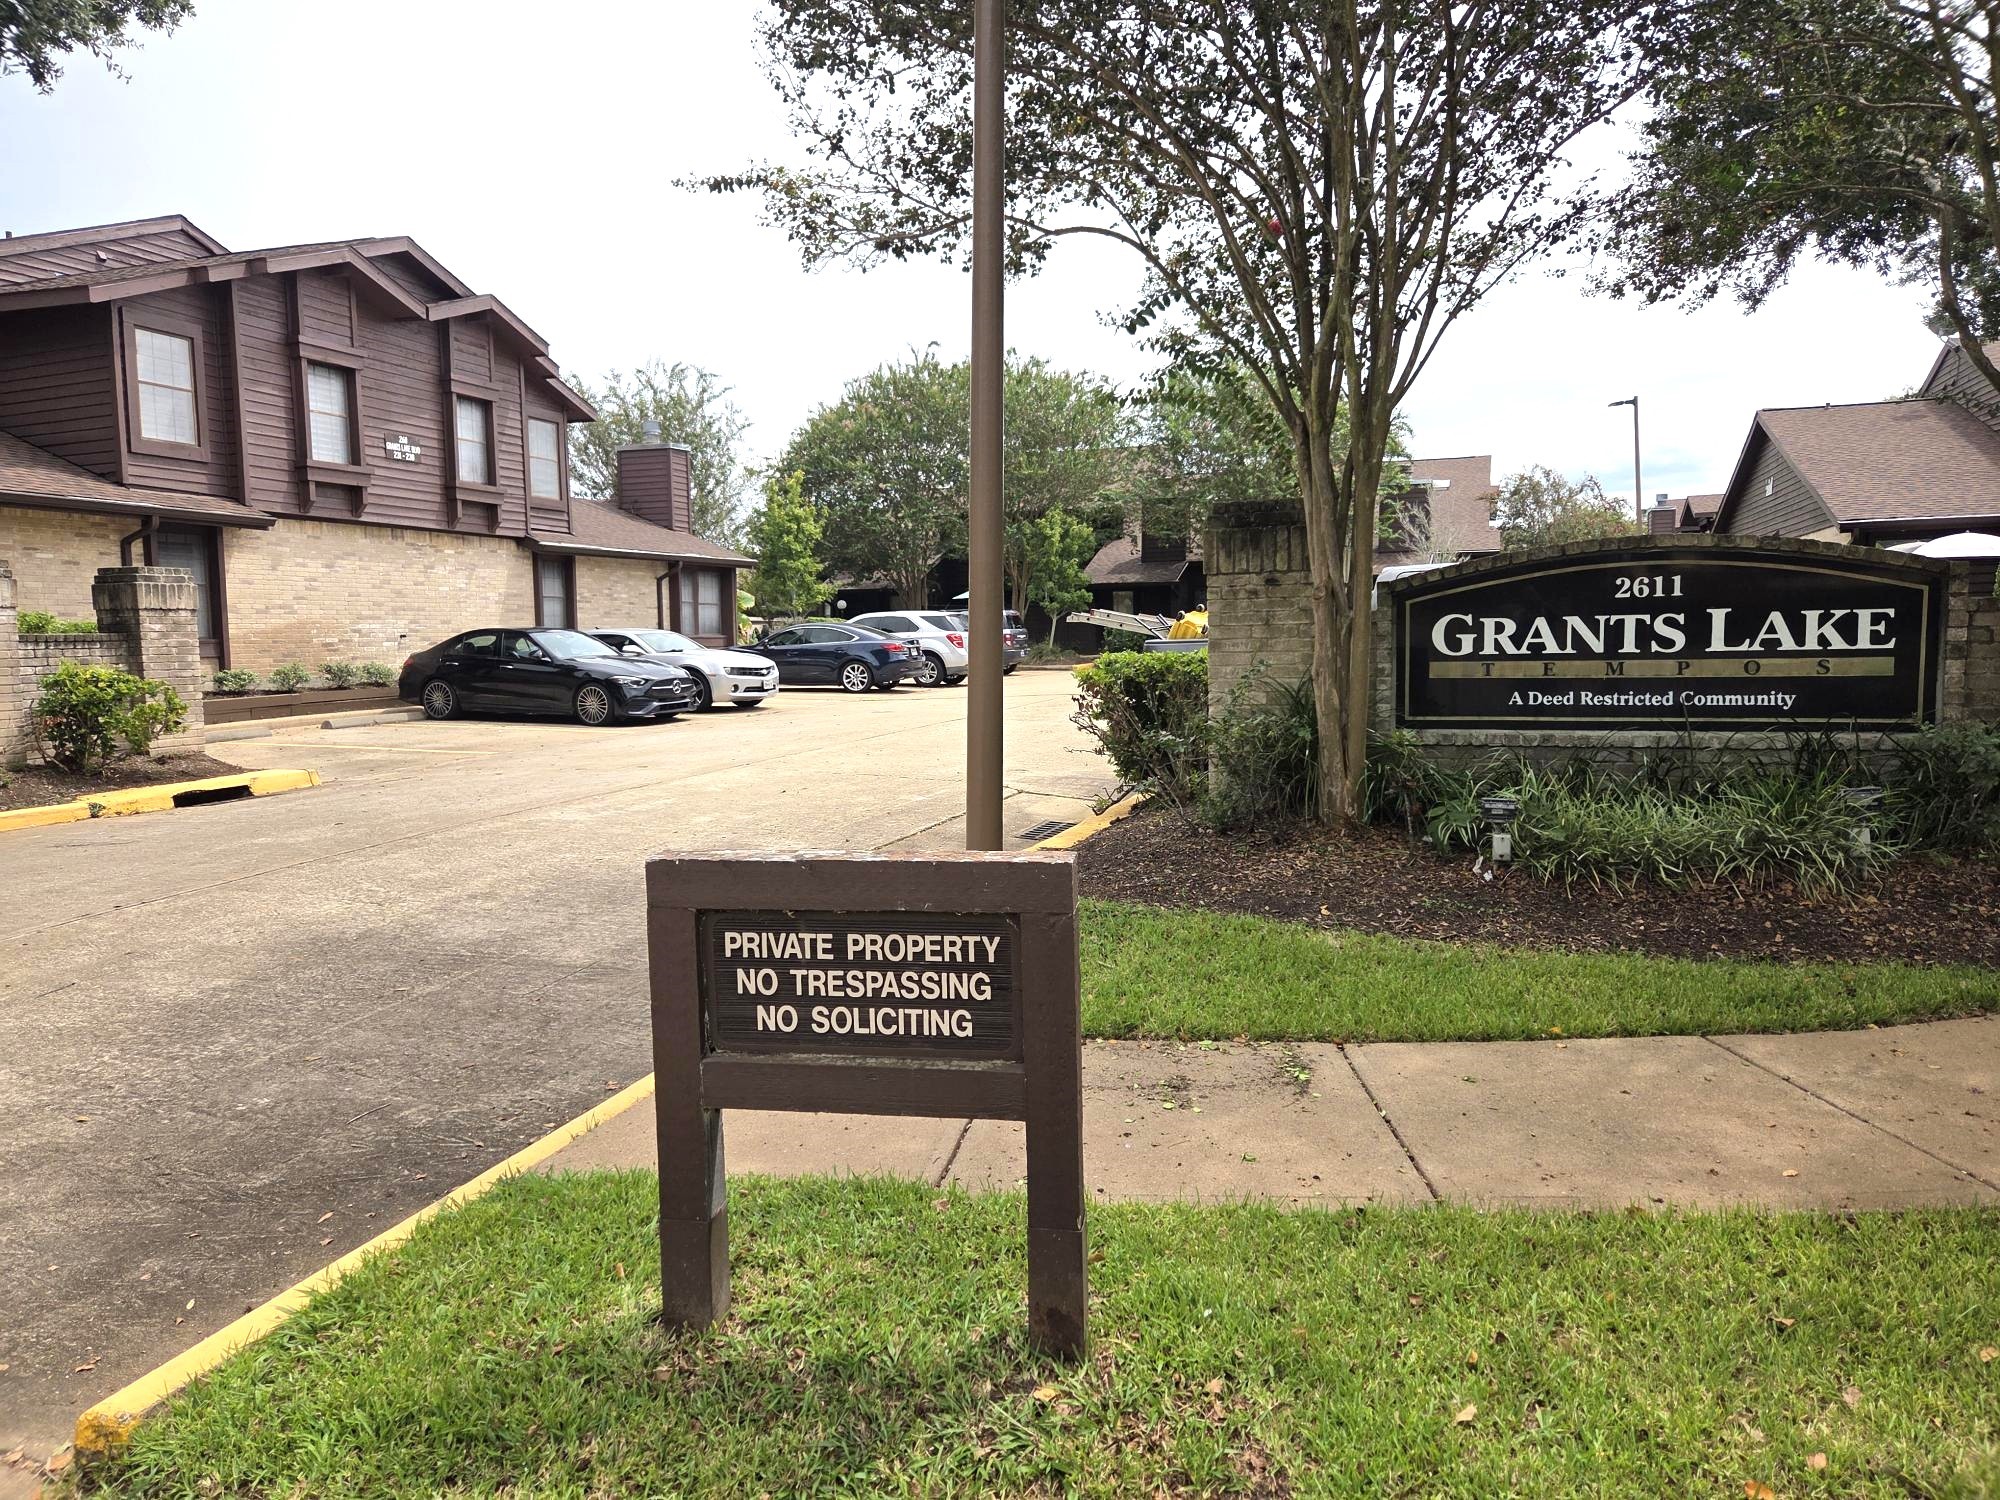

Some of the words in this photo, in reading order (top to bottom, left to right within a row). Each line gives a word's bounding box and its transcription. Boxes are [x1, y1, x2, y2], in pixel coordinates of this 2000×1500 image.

[1614, 574, 1684, 599] 2611
[1431, 612, 1686, 656] GRANTS
[1704, 607, 1897, 652] LAKE
[1508, 691, 1524, 705] A
[1527, 691, 1574, 706] Deed
[1580, 690, 1674, 706] Restricted
[1679, 690, 1797, 710] Community
[724, 931, 834, 960] PRIVATE
[846, 933, 1001, 963] PROPERTY
[736, 967, 779, 996] NO
[789, 969, 992, 1001] TRESPASSING
[756, 1004, 799, 1033] NO
[810, 1005, 973, 1038] SOLICITING
